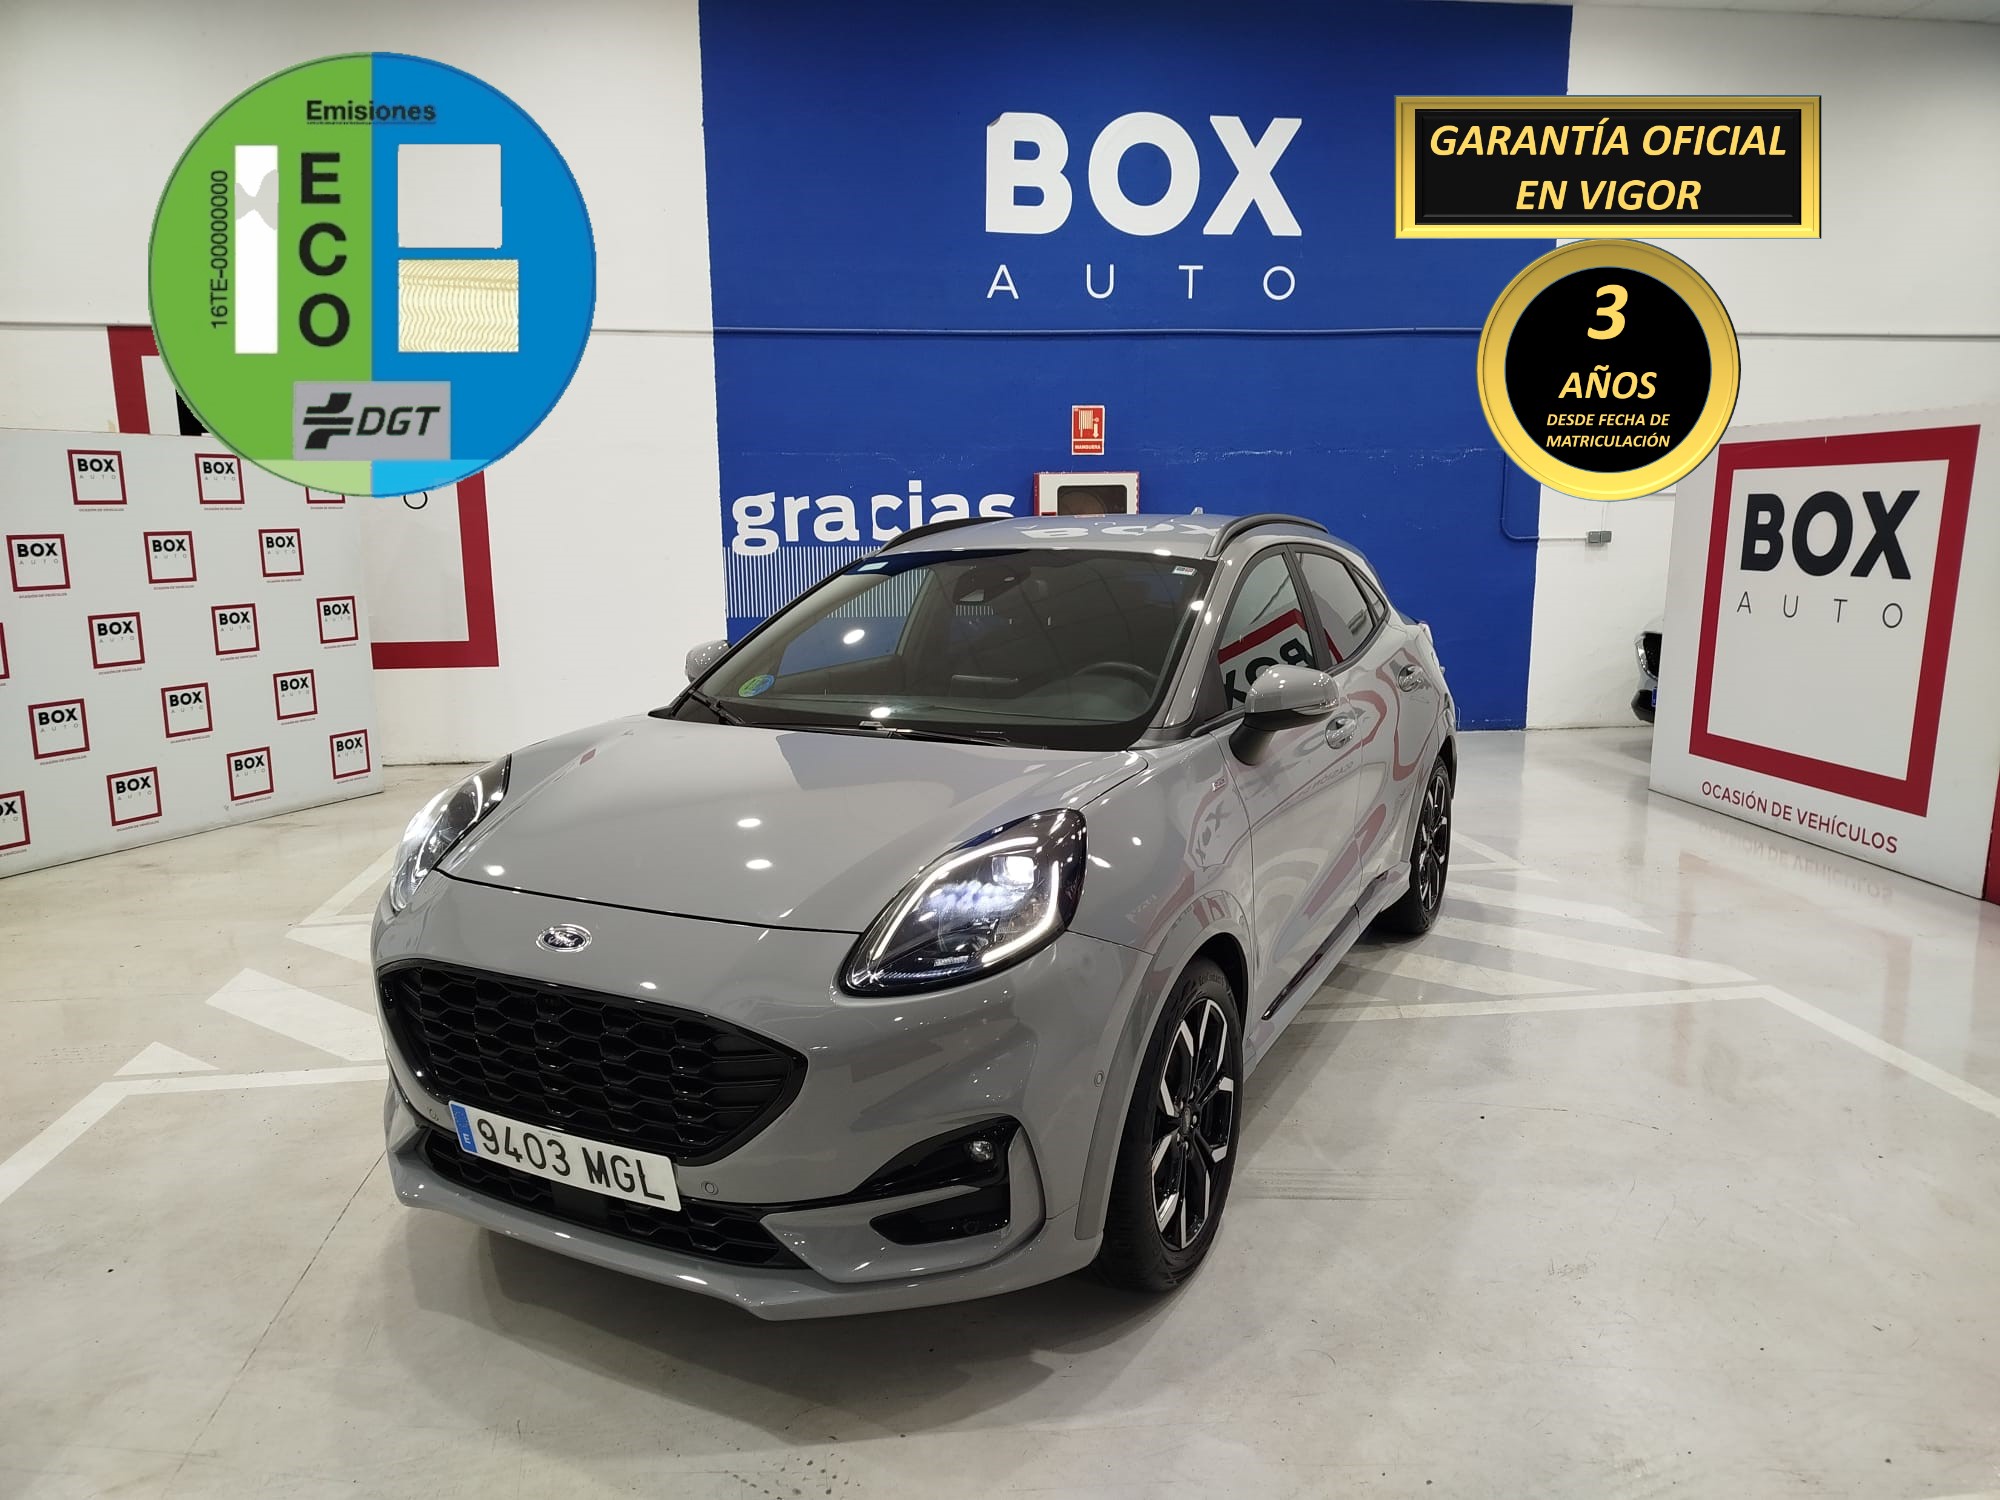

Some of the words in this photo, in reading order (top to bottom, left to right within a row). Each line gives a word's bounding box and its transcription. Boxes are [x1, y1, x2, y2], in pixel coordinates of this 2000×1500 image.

[985, 111, 1303, 237] BOX
[986, 263, 1297, 300] AUTO
[77, 458, 115, 473] BOX
[203, 461, 236, 474] BOX
[266, 535, 296, 549] BOX
[1740, 489, 1920, 580] BOX
[16, 543, 58, 557] BOX
[152, 539, 187, 553] BOX
[323, 603, 351, 616] BOX
[1736, 591, 1904, 629] AUTO
[219, 611, 250, 626] BOX
[97, 621, 134, 636] BOX
[280, 677, 309, 691] BOX
[169, 691, 203, 707] BOX
[38, 708, 78, 725] BOX
[336, 737, 363, 751] BOX
[234, 755, 265, 771] BOX
[115, 775, 152, 794] BOX
[1701, 781, 1768, 814] OCASIÓN
[1771, 801, 1793, 822] DE
[1796, 808, 1899, 854] VEHÍCULOS
[476, 1118, 571, 1177] 9403
[581, 1146, 666, 1202] MGL
